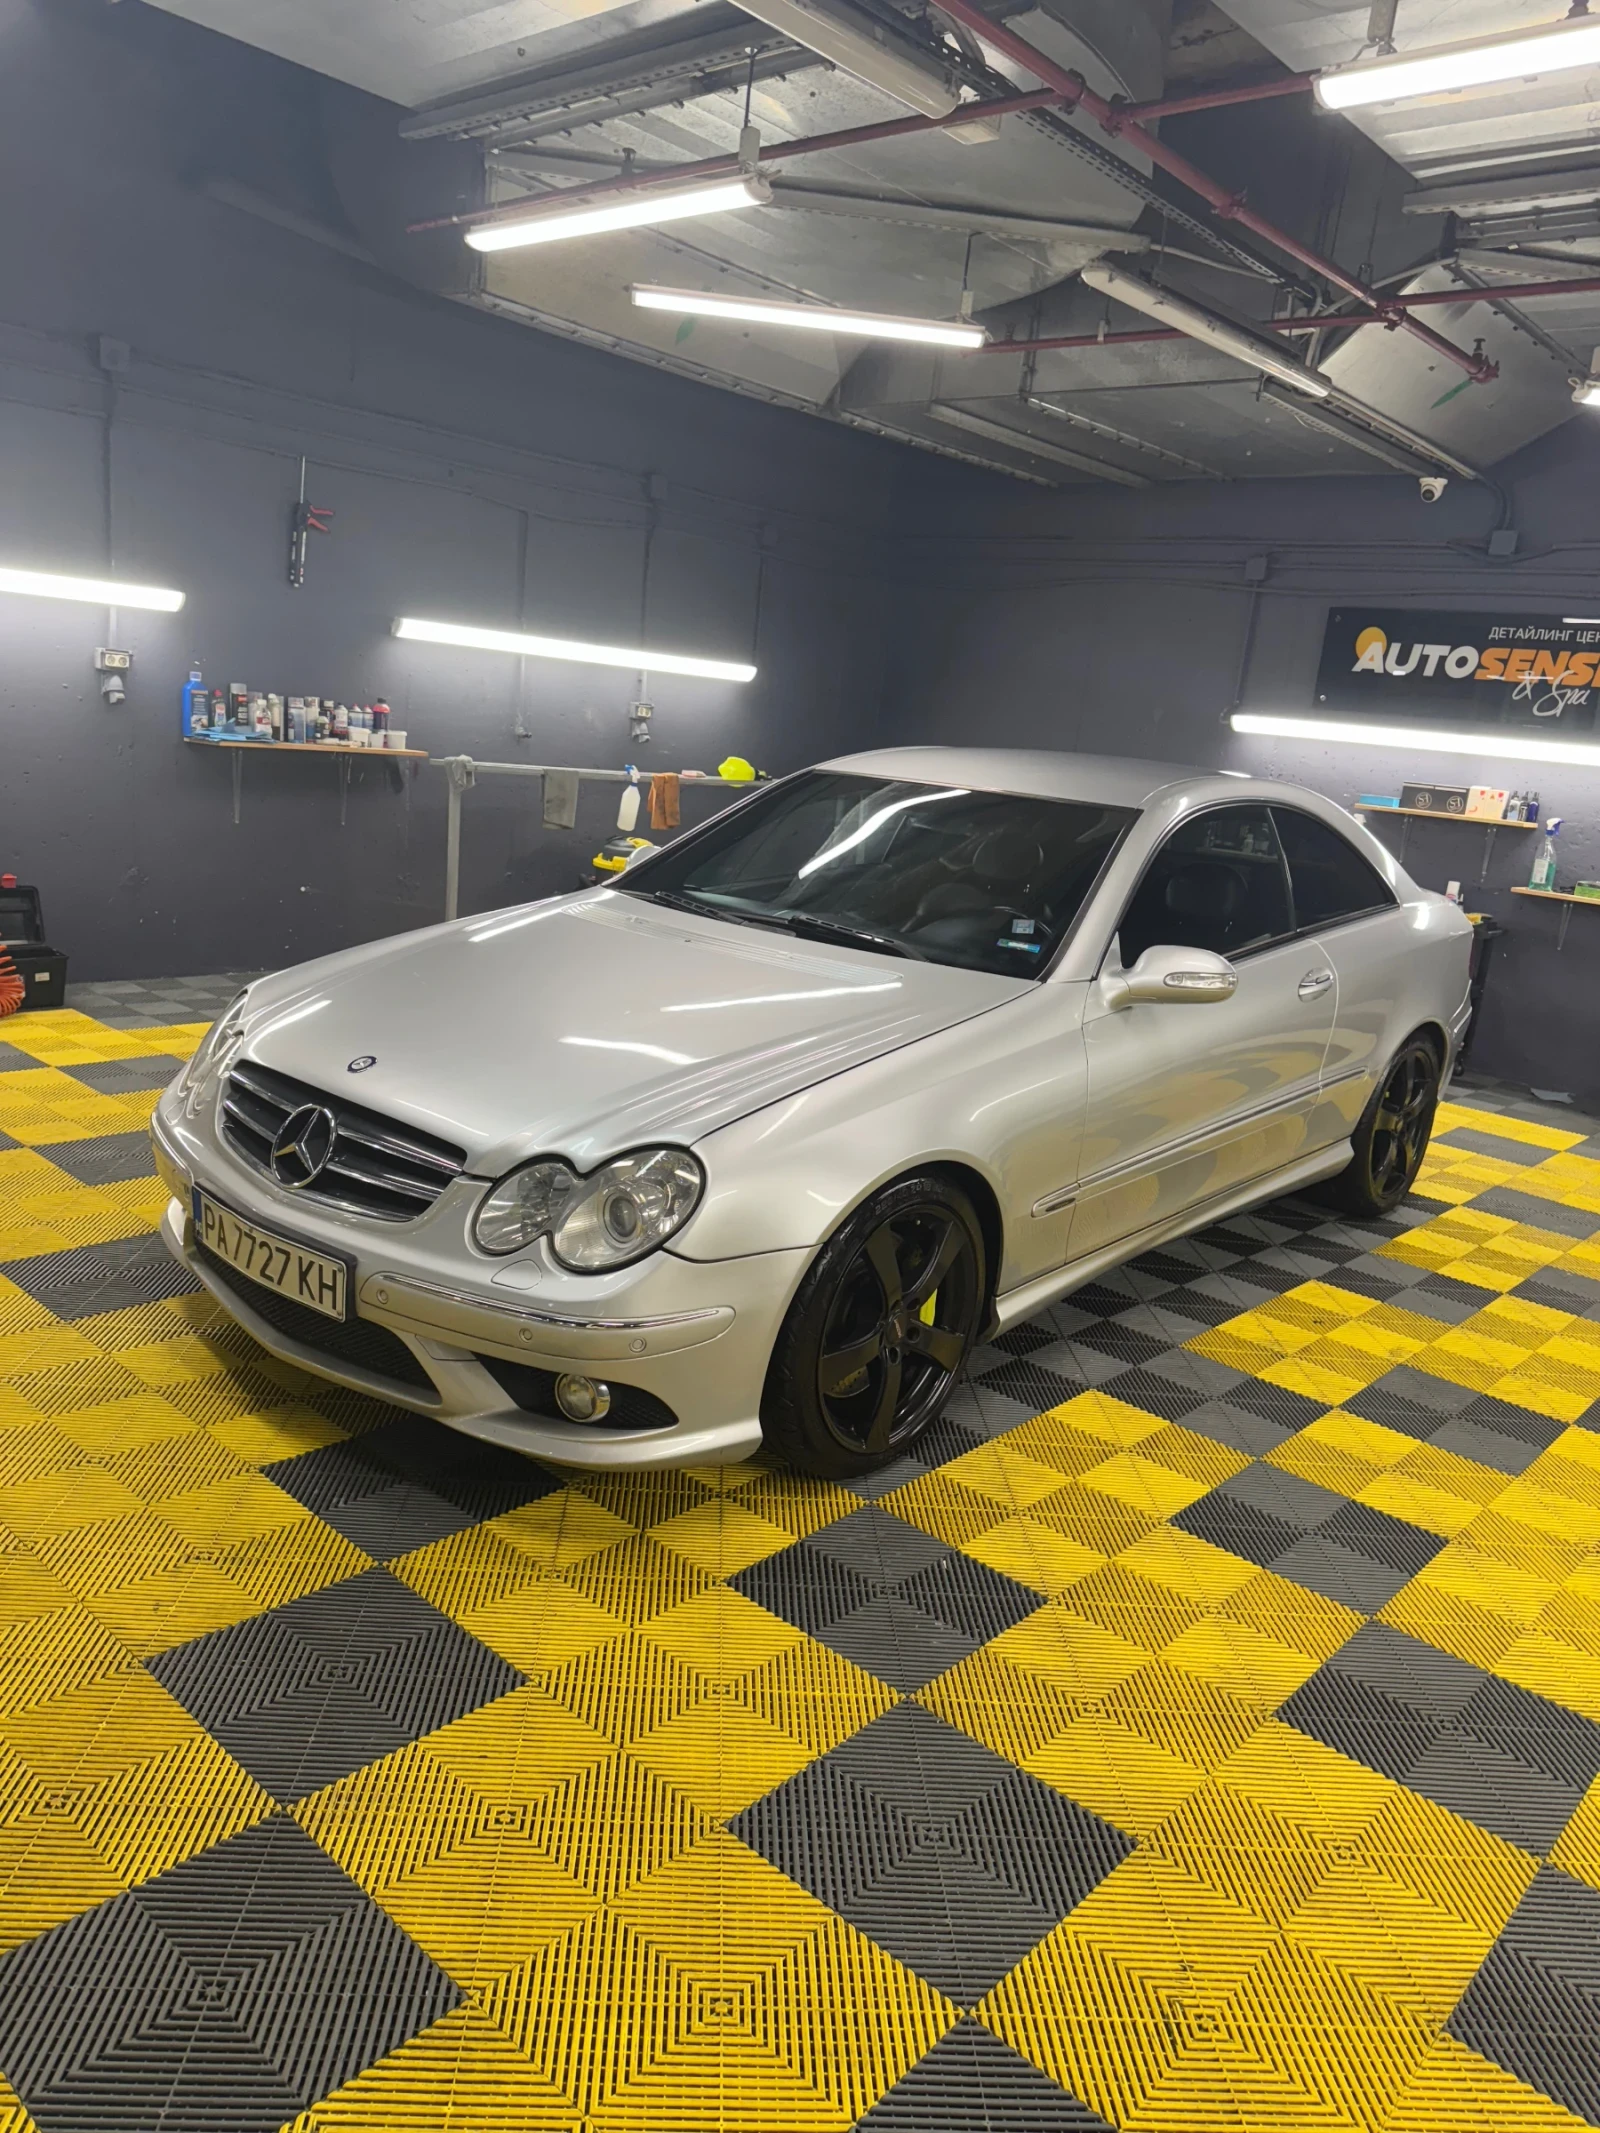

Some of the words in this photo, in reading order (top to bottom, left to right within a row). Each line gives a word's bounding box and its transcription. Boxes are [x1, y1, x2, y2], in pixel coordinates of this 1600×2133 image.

[1488, 626, 1574, 642] ДЕТАЙЛИНГ
[1532, 669, 1591, 717] Spa
[203, 1202, 229, 1256] PA
[233, 1221, 292, 1287] 7727
[298, 1255, 338, 1312] KH
